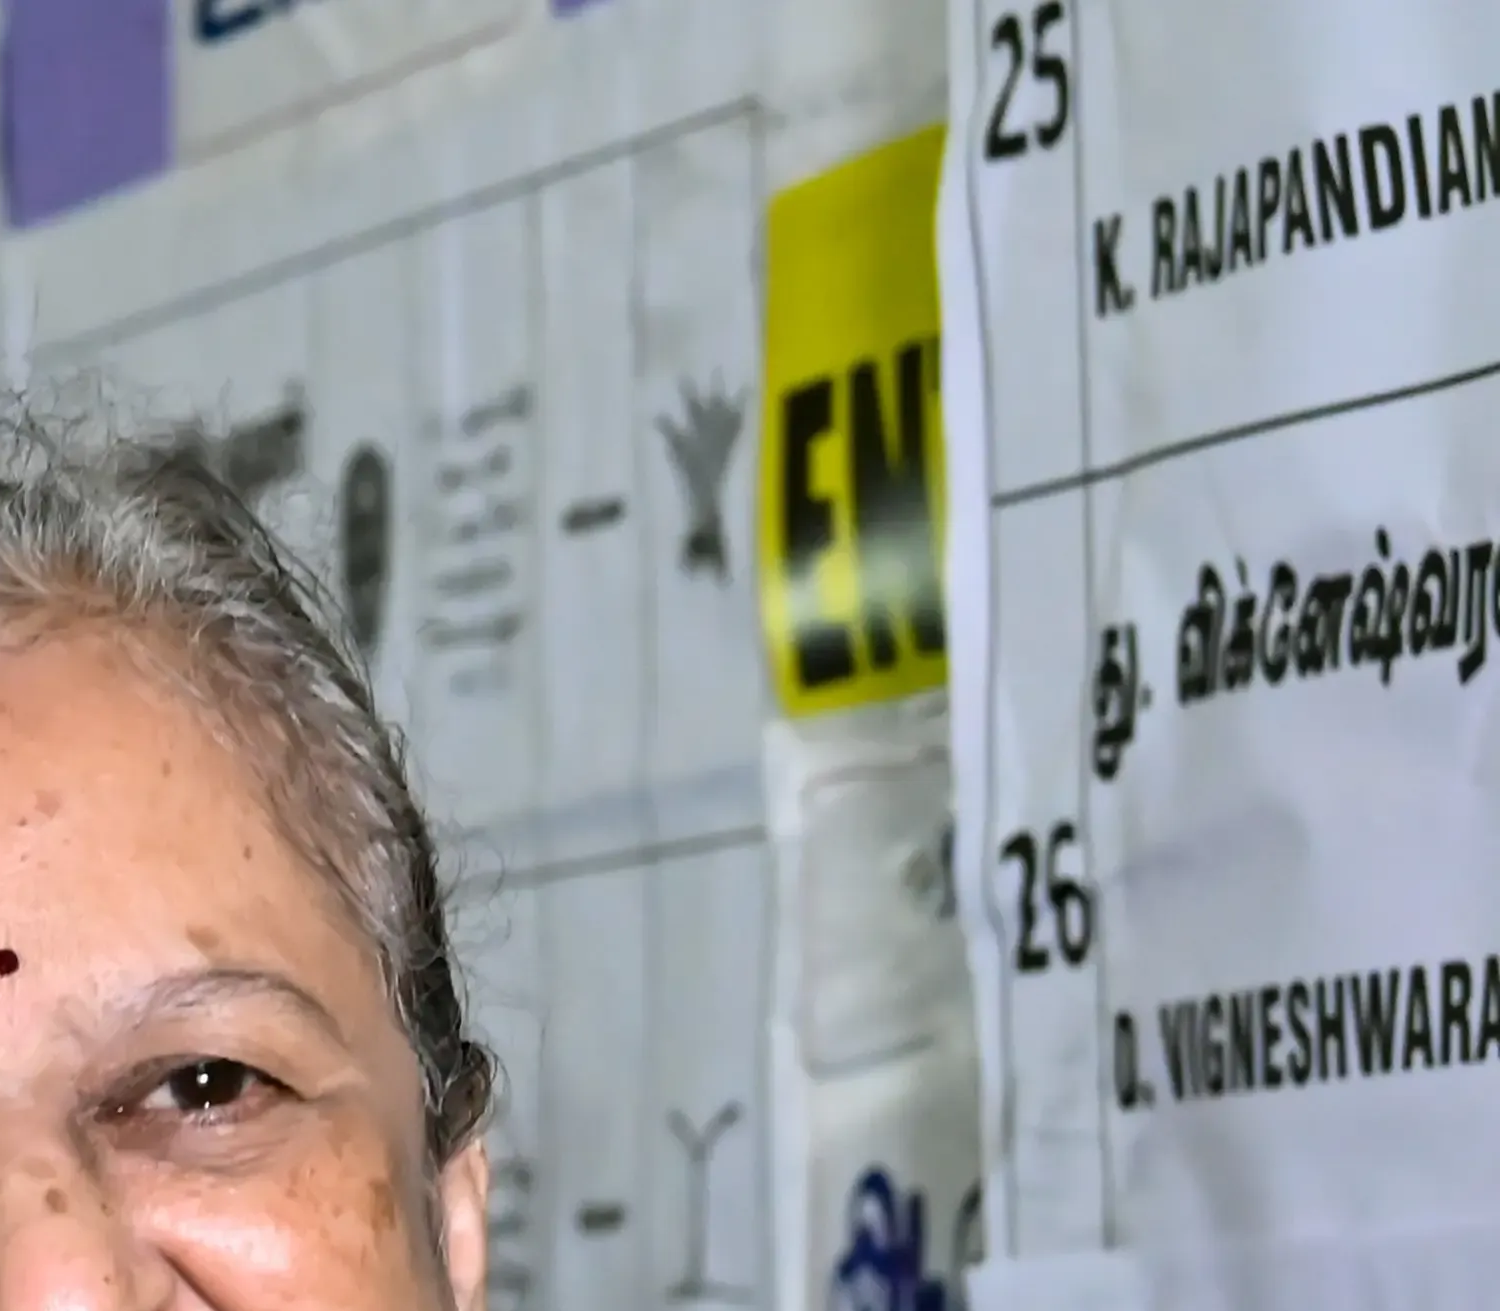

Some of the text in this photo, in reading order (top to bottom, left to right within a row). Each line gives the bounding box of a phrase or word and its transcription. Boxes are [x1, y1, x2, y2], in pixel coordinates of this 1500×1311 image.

[985, 1, 1070, 162] 25
[1093, 88, 1500, 320] K. RAJAPANDIAN
[780, 335, 949, 690] EN
[1177, 524, 1500, 708] விக்னேஷ்வர
[1001, 824, 1093, 972] 26
